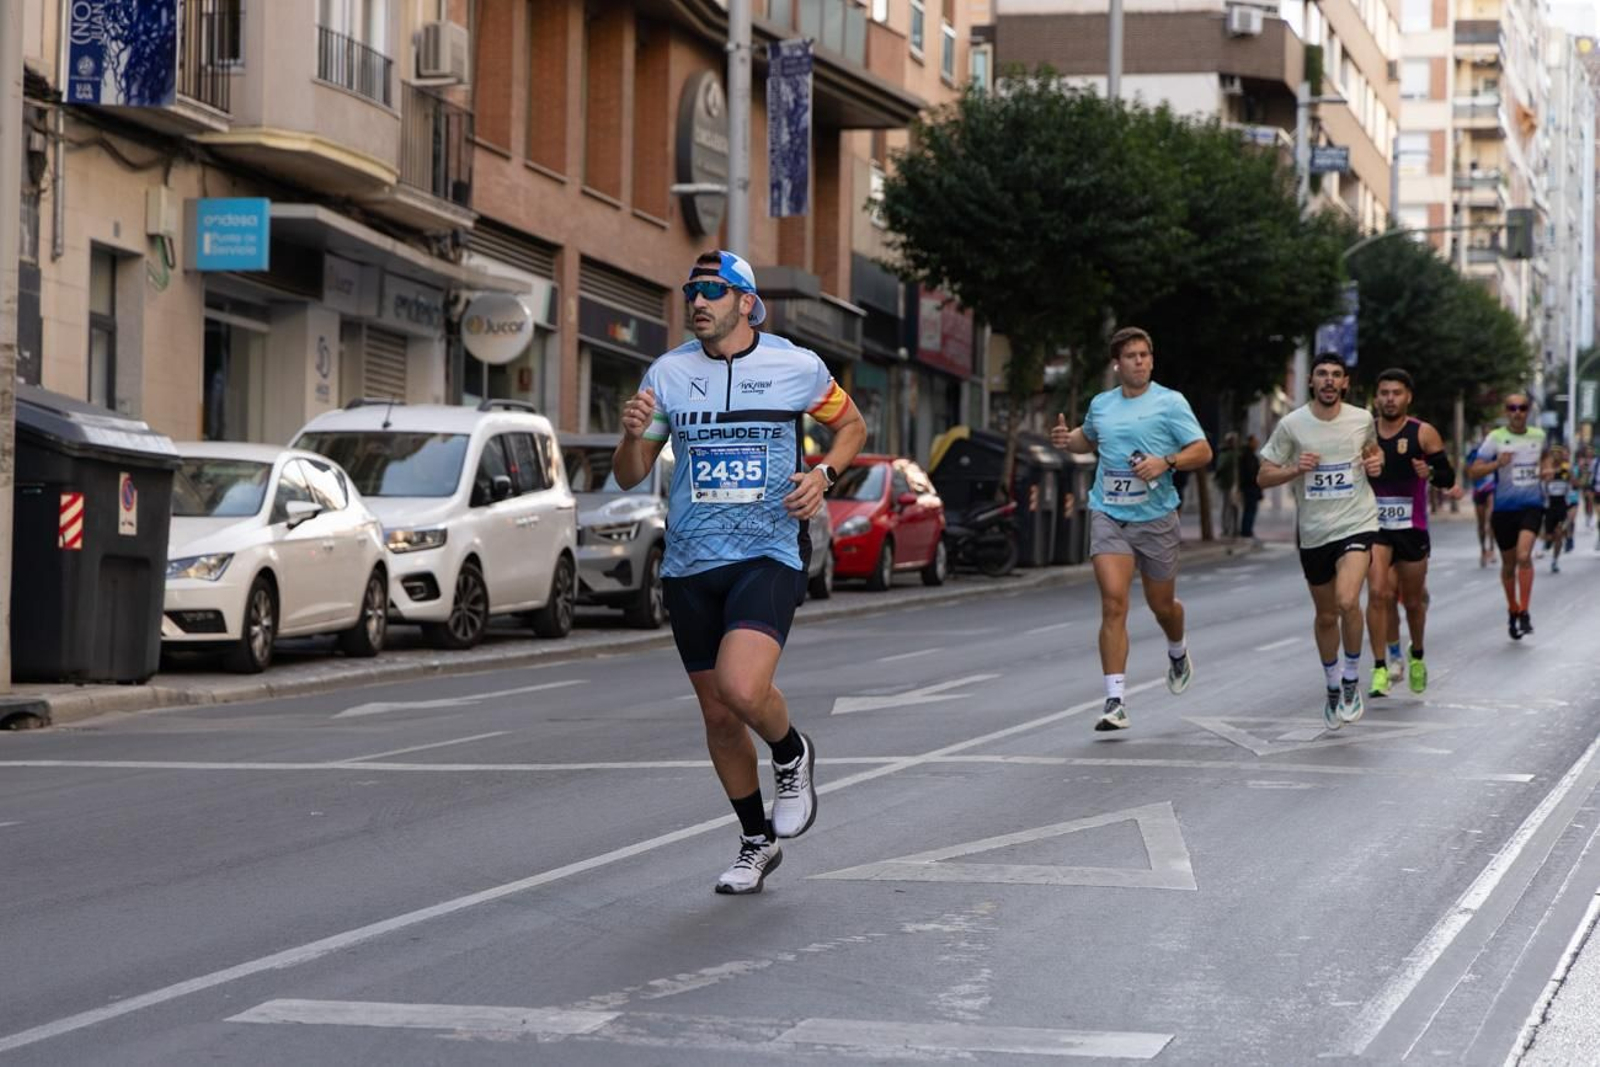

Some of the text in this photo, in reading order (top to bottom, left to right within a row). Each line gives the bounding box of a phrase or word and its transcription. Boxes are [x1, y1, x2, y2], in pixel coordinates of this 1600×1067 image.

[678, 427, 781, 443] ALCAUDETE
[697, 460, 762, 481] 2435
[1114, 480, 1131, 492] 27
[1314, 473, 1345, 486] 512
[1379, 507, 1405, 518] 280
